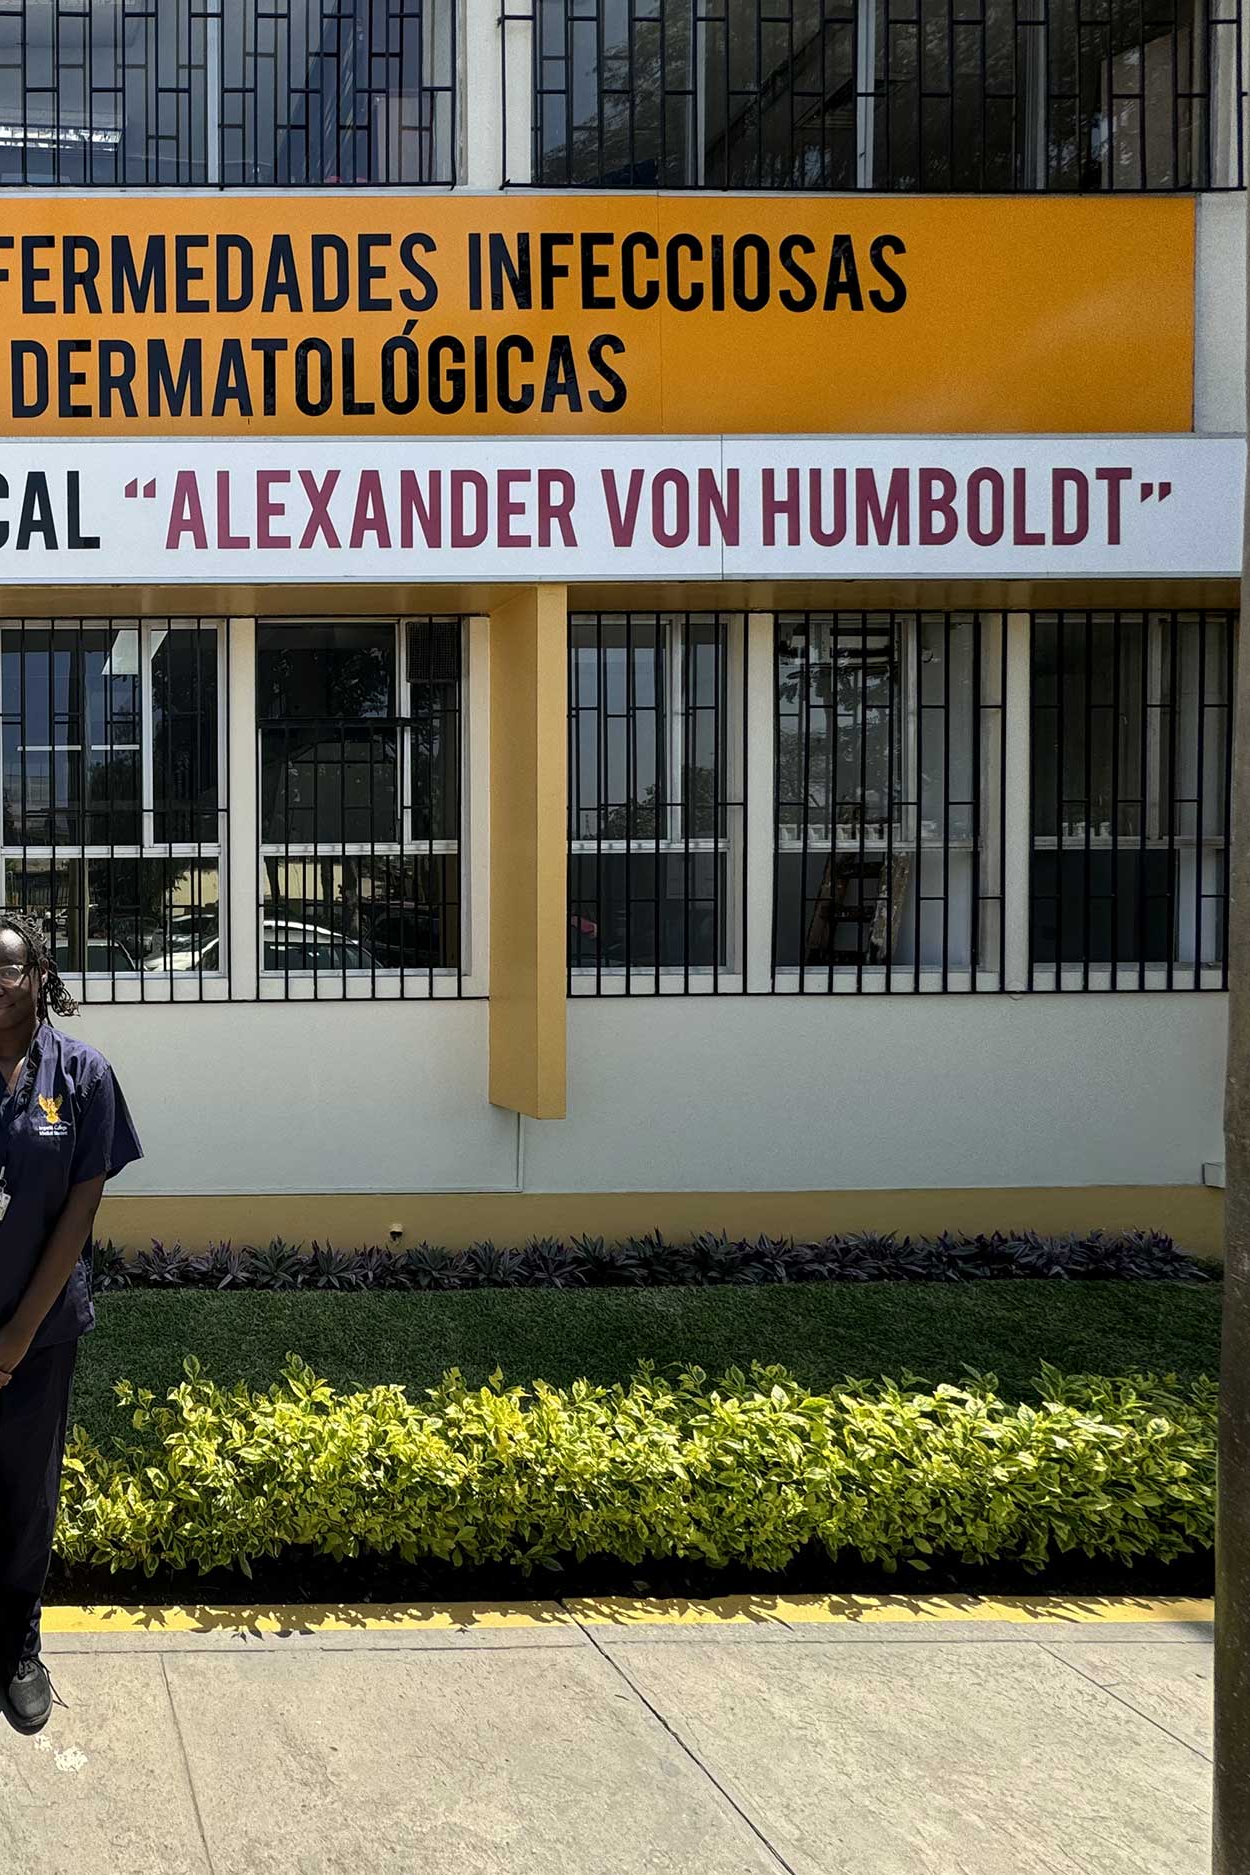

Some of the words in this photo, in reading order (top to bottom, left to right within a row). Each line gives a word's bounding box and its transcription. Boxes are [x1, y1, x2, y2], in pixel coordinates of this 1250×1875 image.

[469, 232, 906, 313] INFECCIOSAS
[11, 320, 626, 418] DERMATOLÓGICAS
[601, 469, 739, 547] VON
